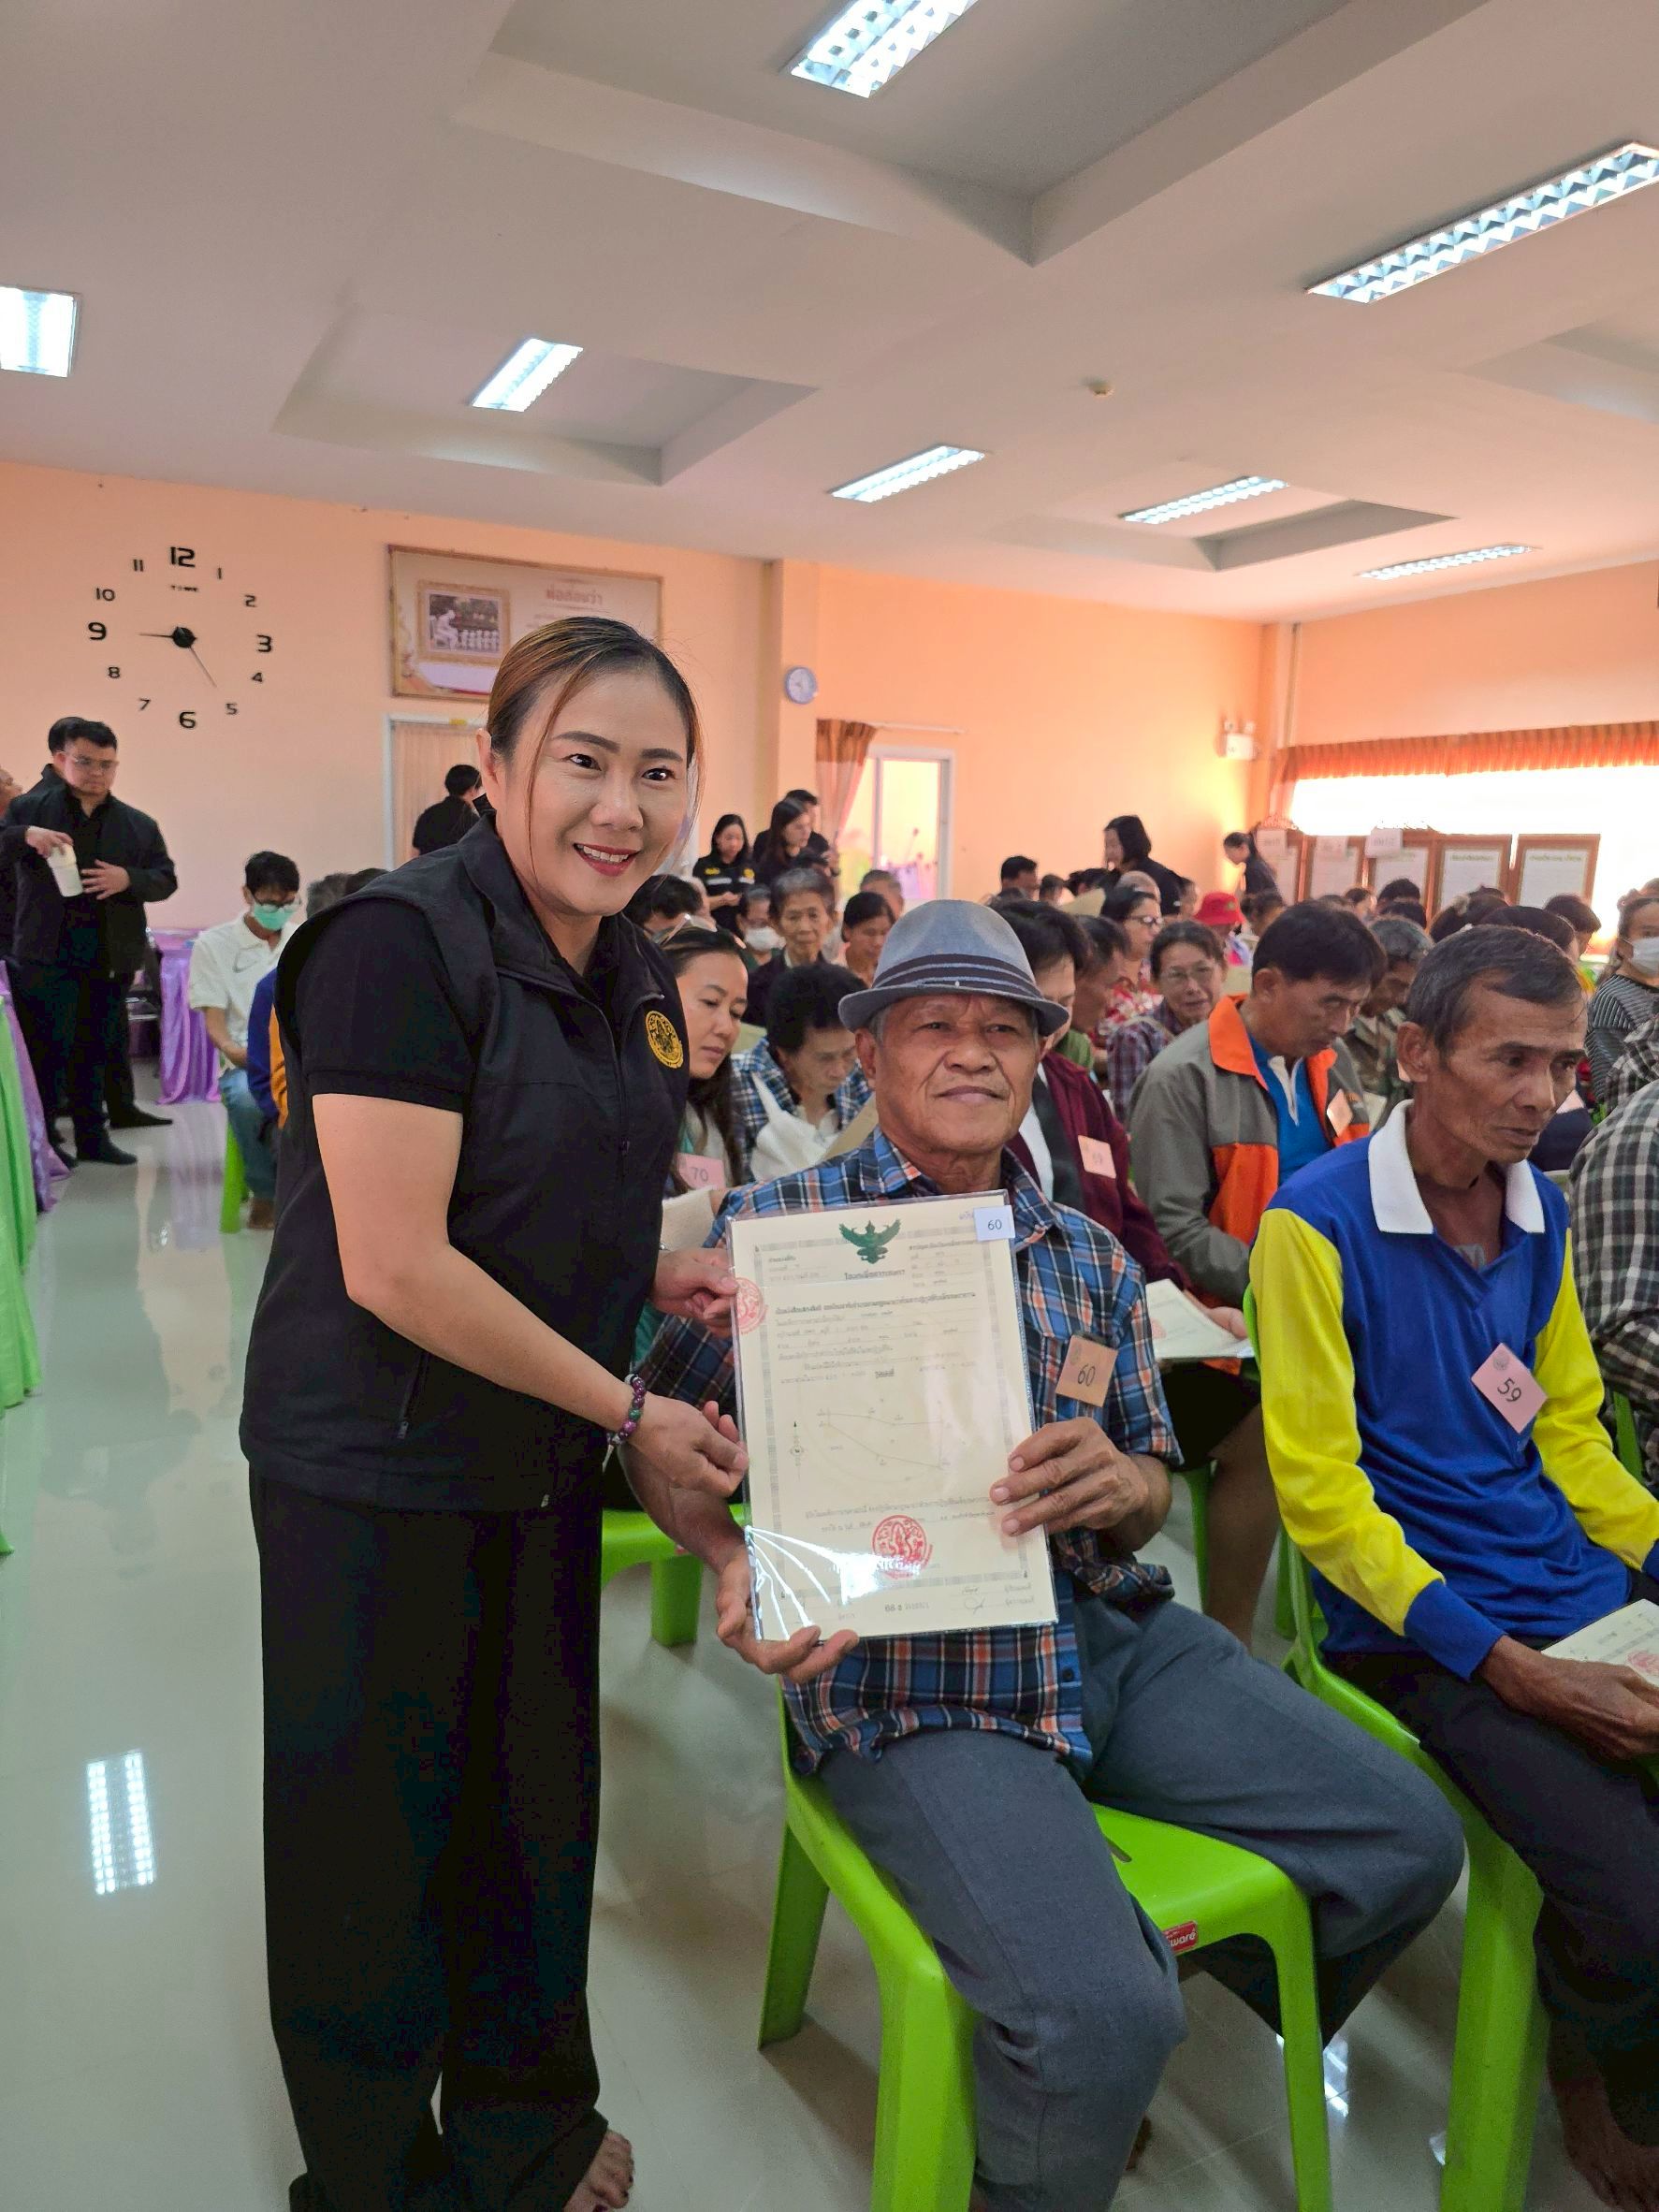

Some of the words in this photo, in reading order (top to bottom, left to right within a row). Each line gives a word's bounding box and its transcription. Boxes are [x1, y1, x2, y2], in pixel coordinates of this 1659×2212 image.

[169, 546, 196, 568] 12
[133, 559, 144, 572] 11
[217, 567, 223, 579] 1
[96, 588, 116, 602] 10
[244, 594, 257, 607] 2
[88, 621, 107, 641] 9
[256, 633, 273, 653] 3
[107, 666, 121, 679] 8
[251, 672, 264, 684] 4
[138, 698, 151, 711] 7
[226, 703, 238, 716] 5
[178, 710, 196, 730] 6
[690, 1166, 708, 1182] 70
[987, 1219, 1002, 1230] 60
[1077, 1363, 1096, 1387] 60
[1497, 1377, 1521, 1403] 59
